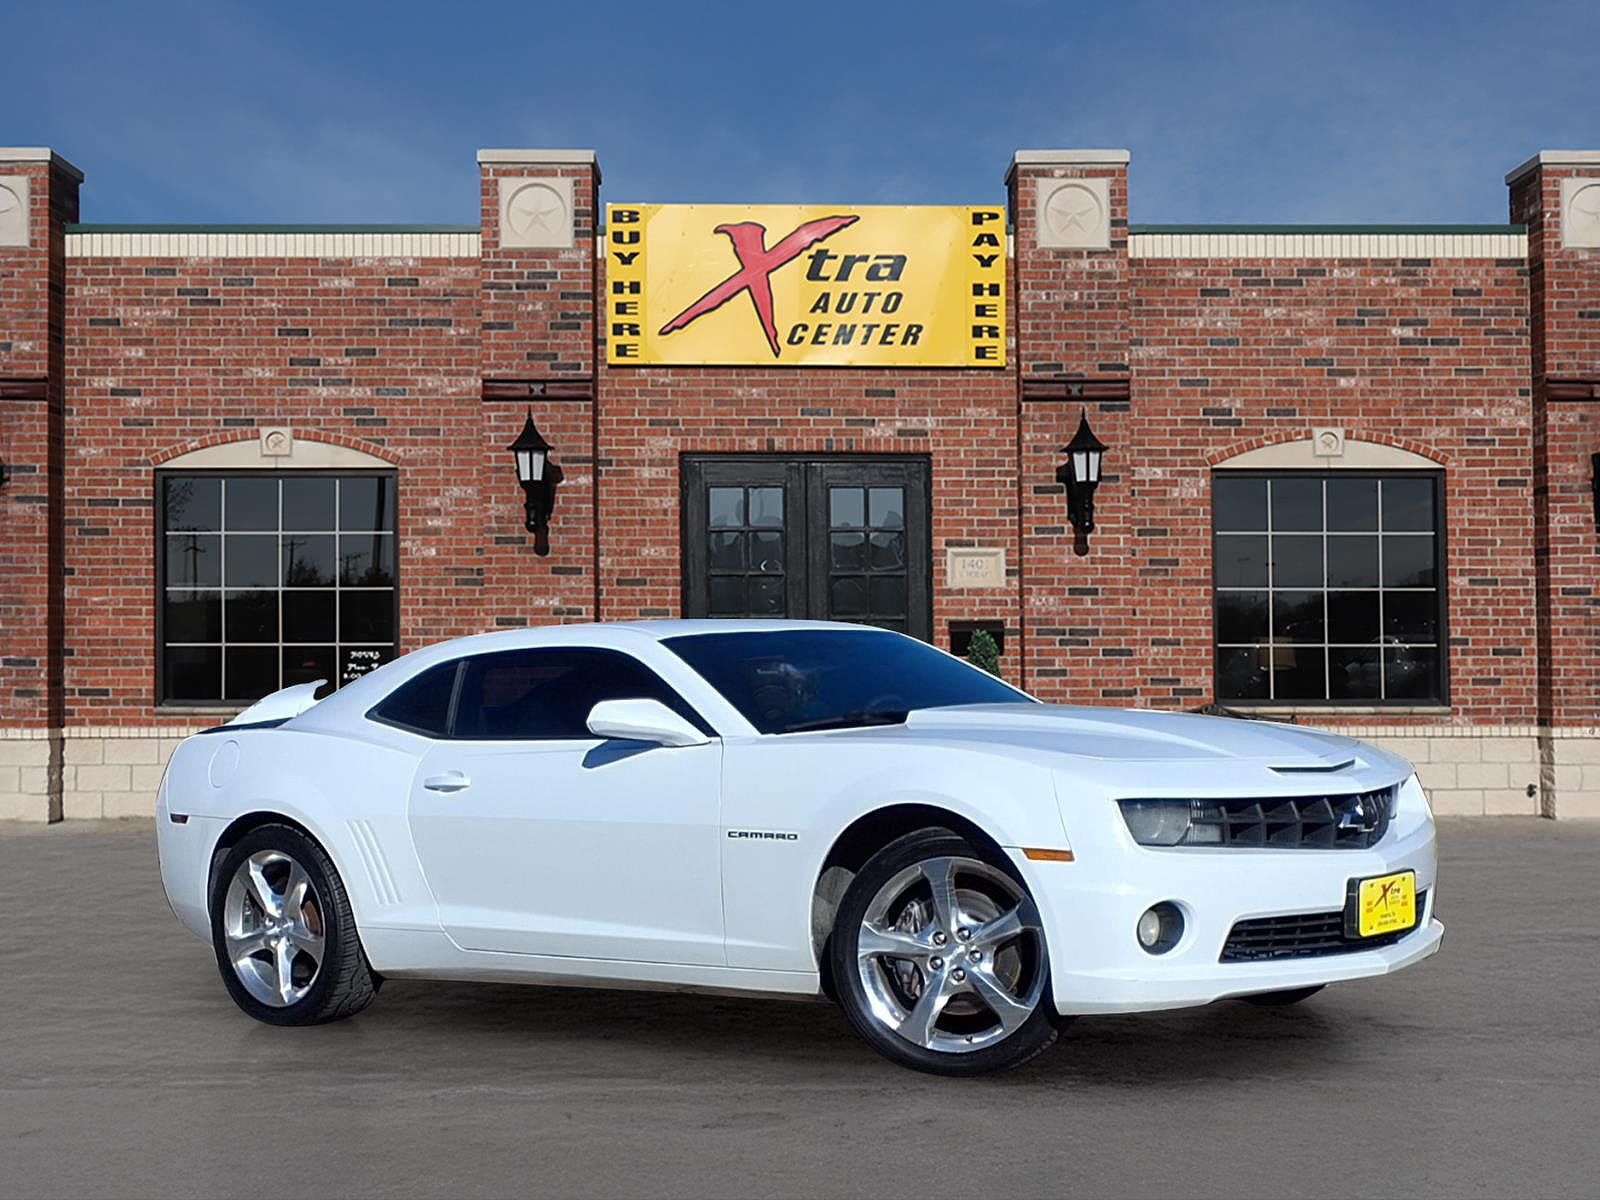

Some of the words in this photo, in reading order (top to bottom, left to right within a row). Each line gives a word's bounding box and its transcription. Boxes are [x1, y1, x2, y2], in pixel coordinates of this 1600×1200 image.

[612, 210, 640, 266] BUY
[972, 212, 1000, 267] PAY
[612, 281, 641, 358] HERE
[809, 292, 904, 314] AUTO
[972, 283, 1000, 360] HERE
[786, 323, 924, 346] CENTER
[727, 830, 798, 841] CAMARO
